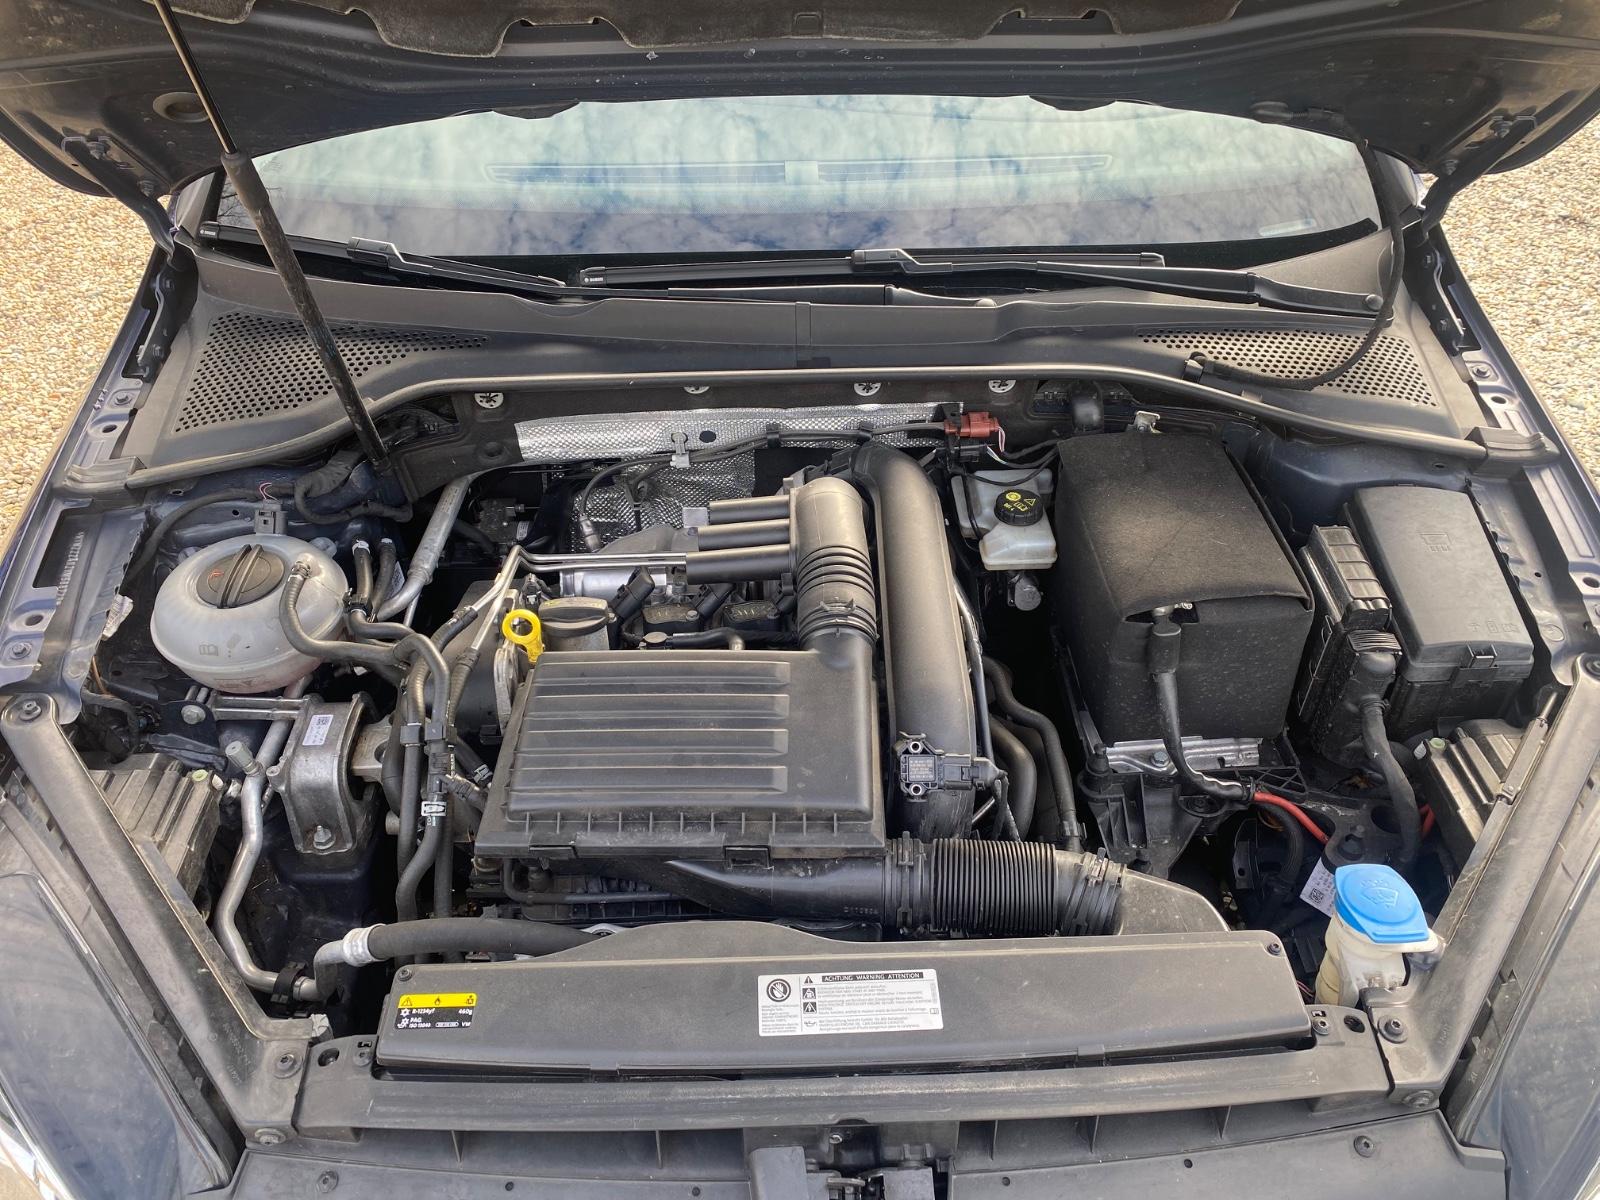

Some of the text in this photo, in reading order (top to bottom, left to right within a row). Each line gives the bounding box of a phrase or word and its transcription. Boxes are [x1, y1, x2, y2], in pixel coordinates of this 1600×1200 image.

[824, 972, 920, 982] ACHTUNG WARNING ATTENTION
